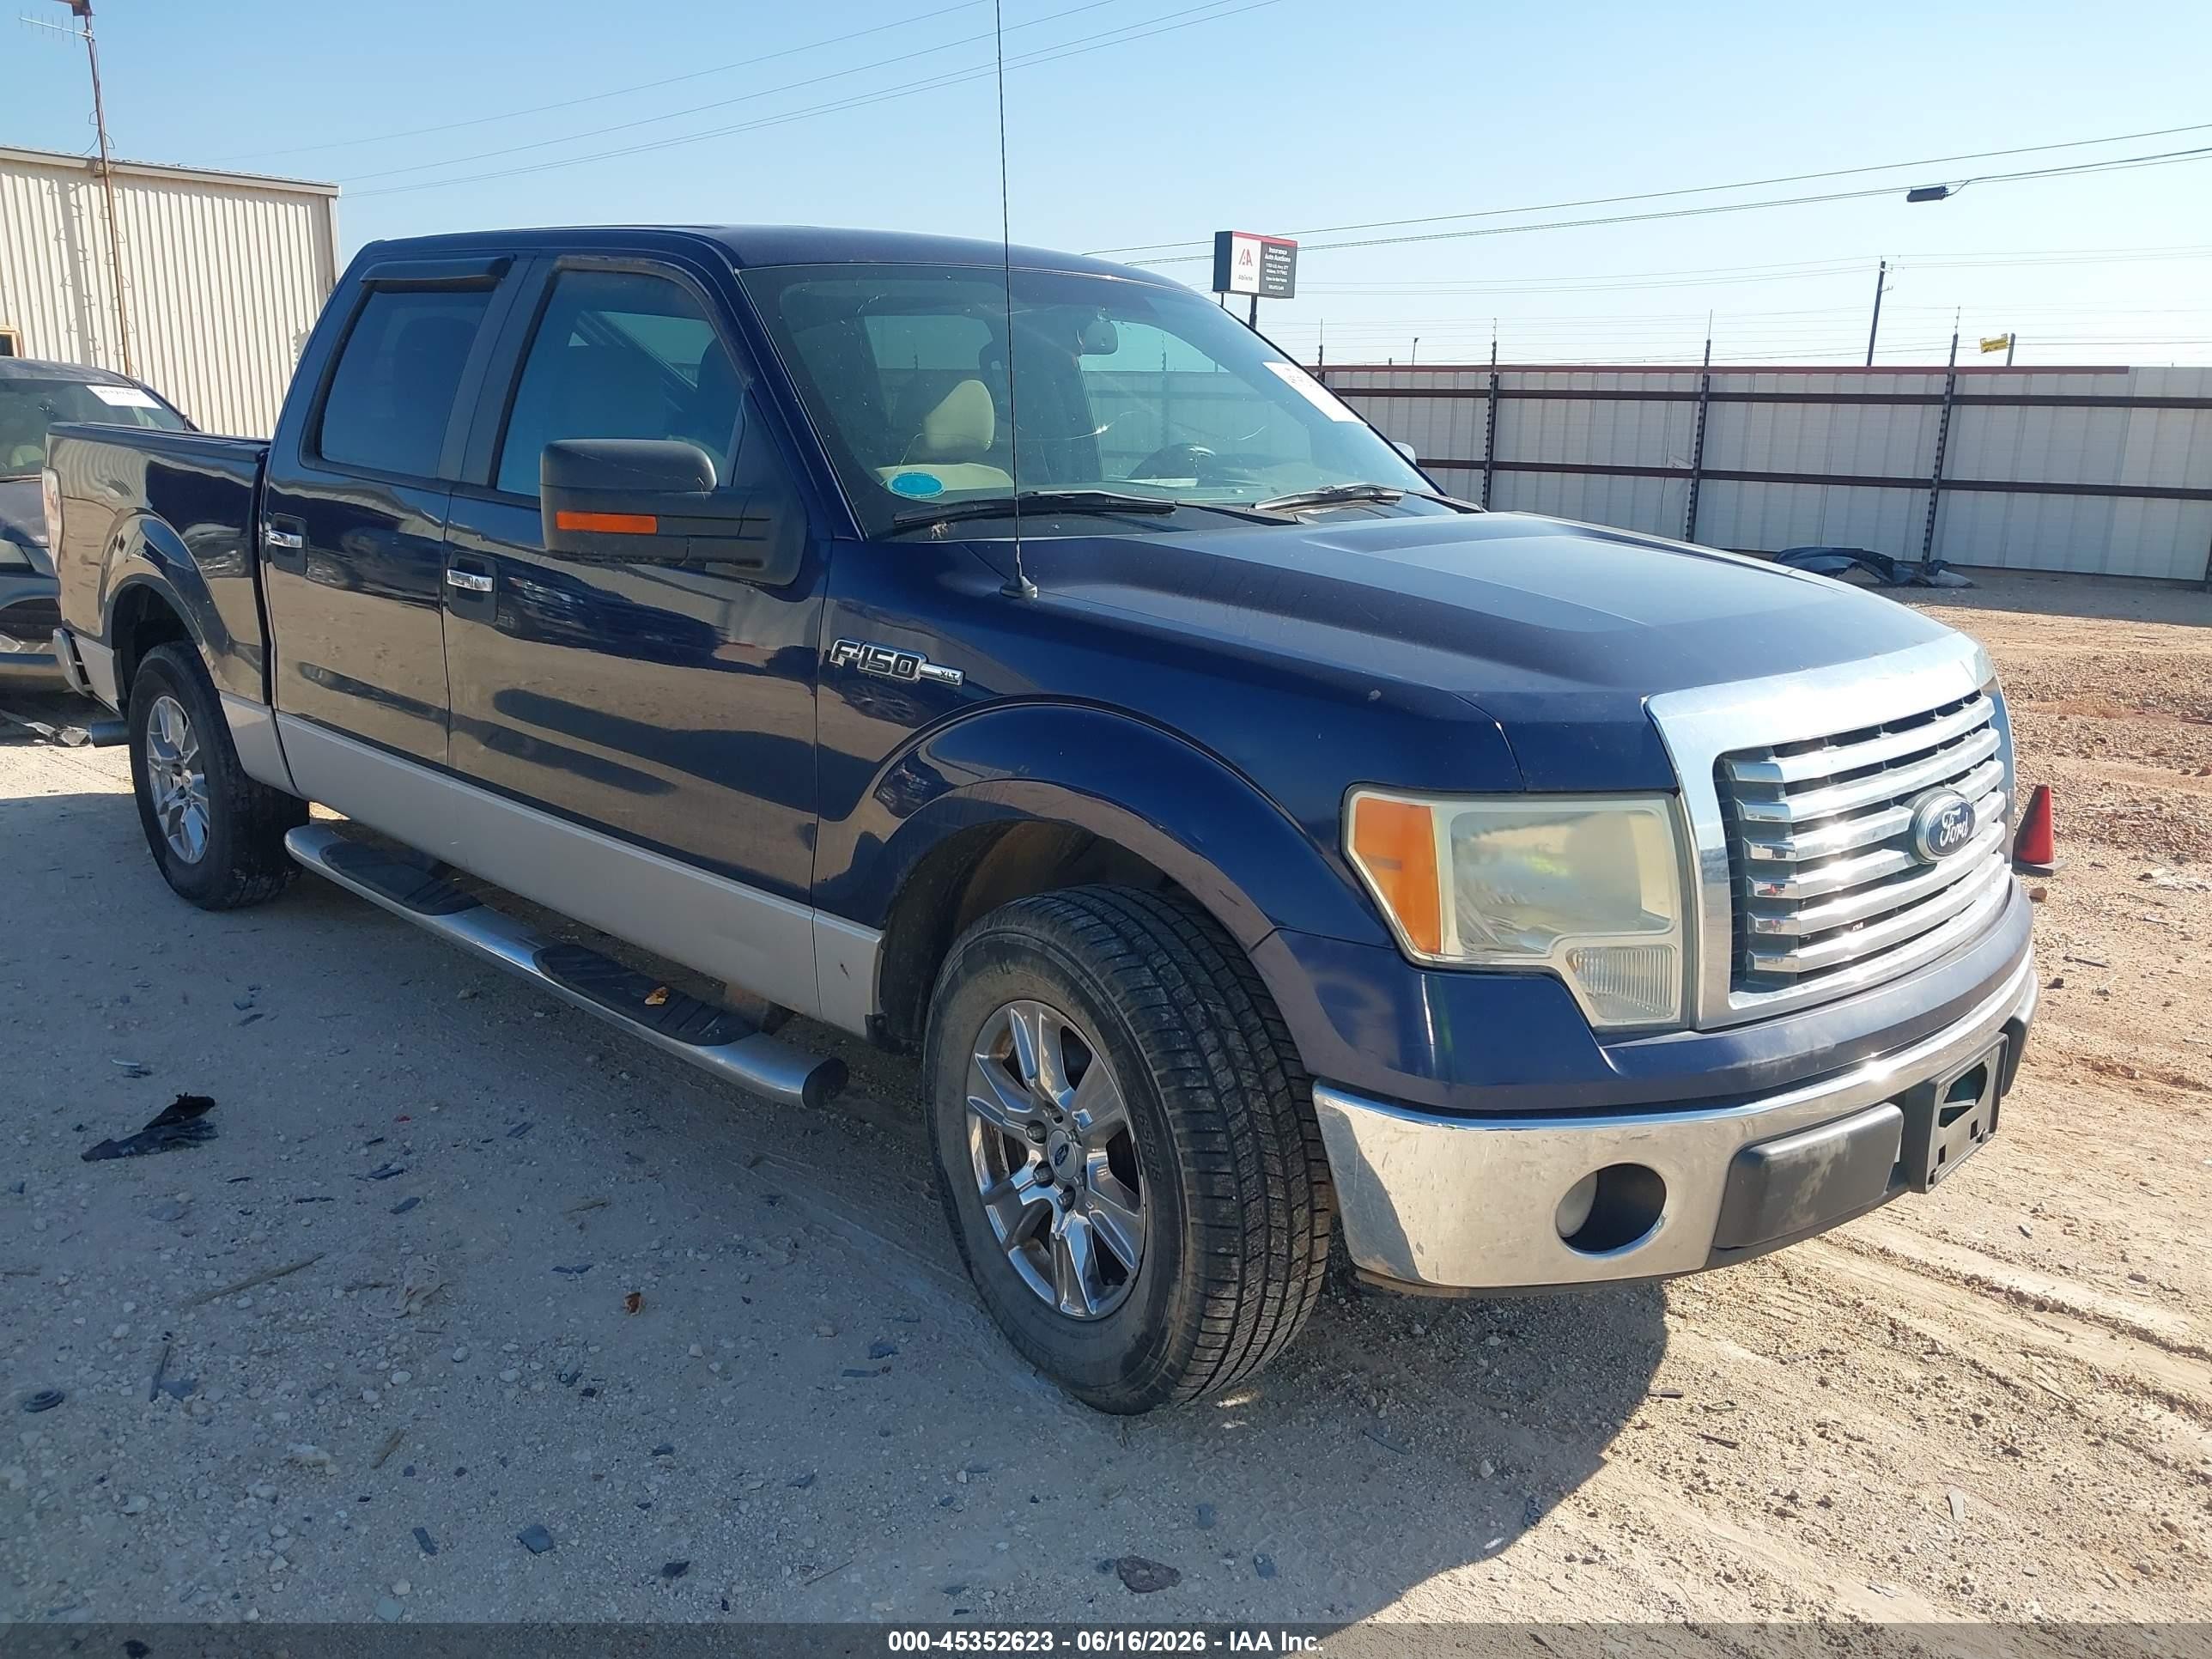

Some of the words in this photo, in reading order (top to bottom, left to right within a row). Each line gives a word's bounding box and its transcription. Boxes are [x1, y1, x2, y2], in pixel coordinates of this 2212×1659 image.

[830, 639, 922, 682] F-150
[939, 669, 958, 681] XLT
[1939, 807, 1969, 847] Ford
